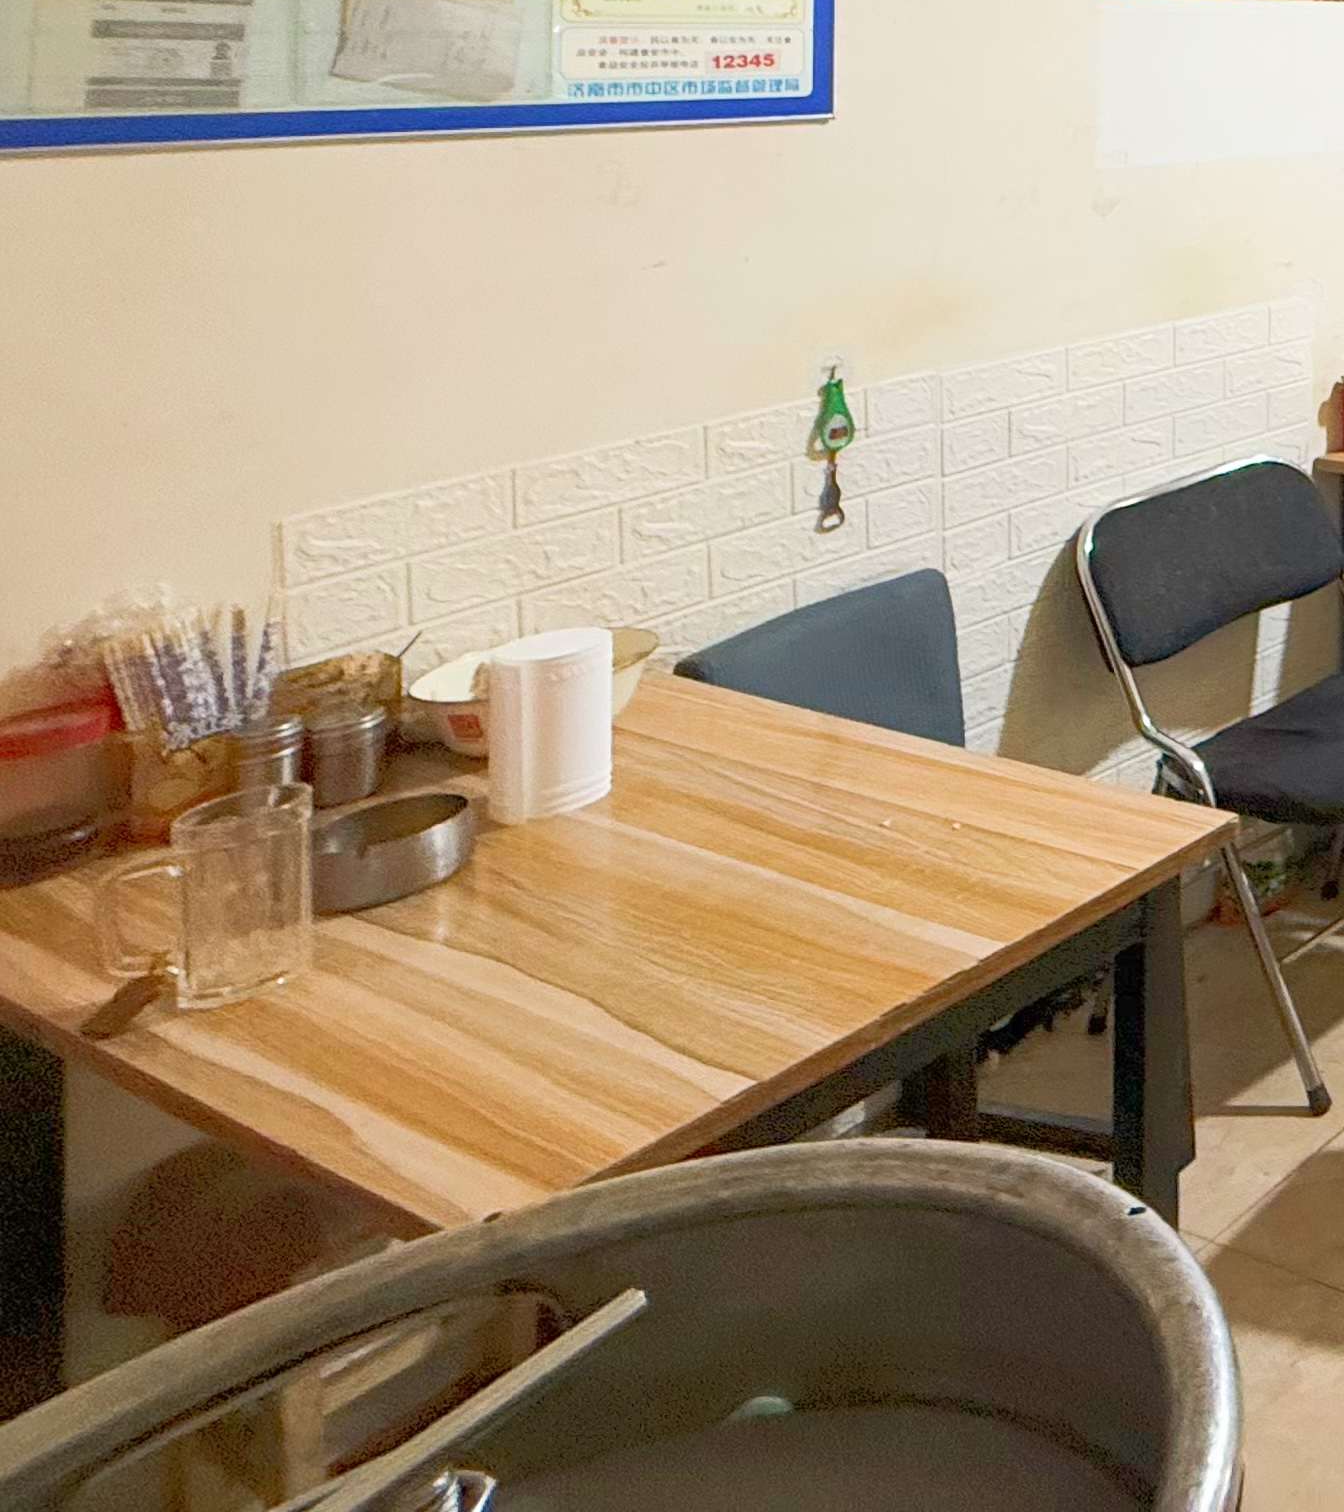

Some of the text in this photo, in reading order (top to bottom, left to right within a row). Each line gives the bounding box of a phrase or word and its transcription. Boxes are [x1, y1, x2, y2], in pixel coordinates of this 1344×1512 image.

[711, 52, 775, 70] 12345
[567, 77, 801, 99] 济南市市中区市场监督管理局
